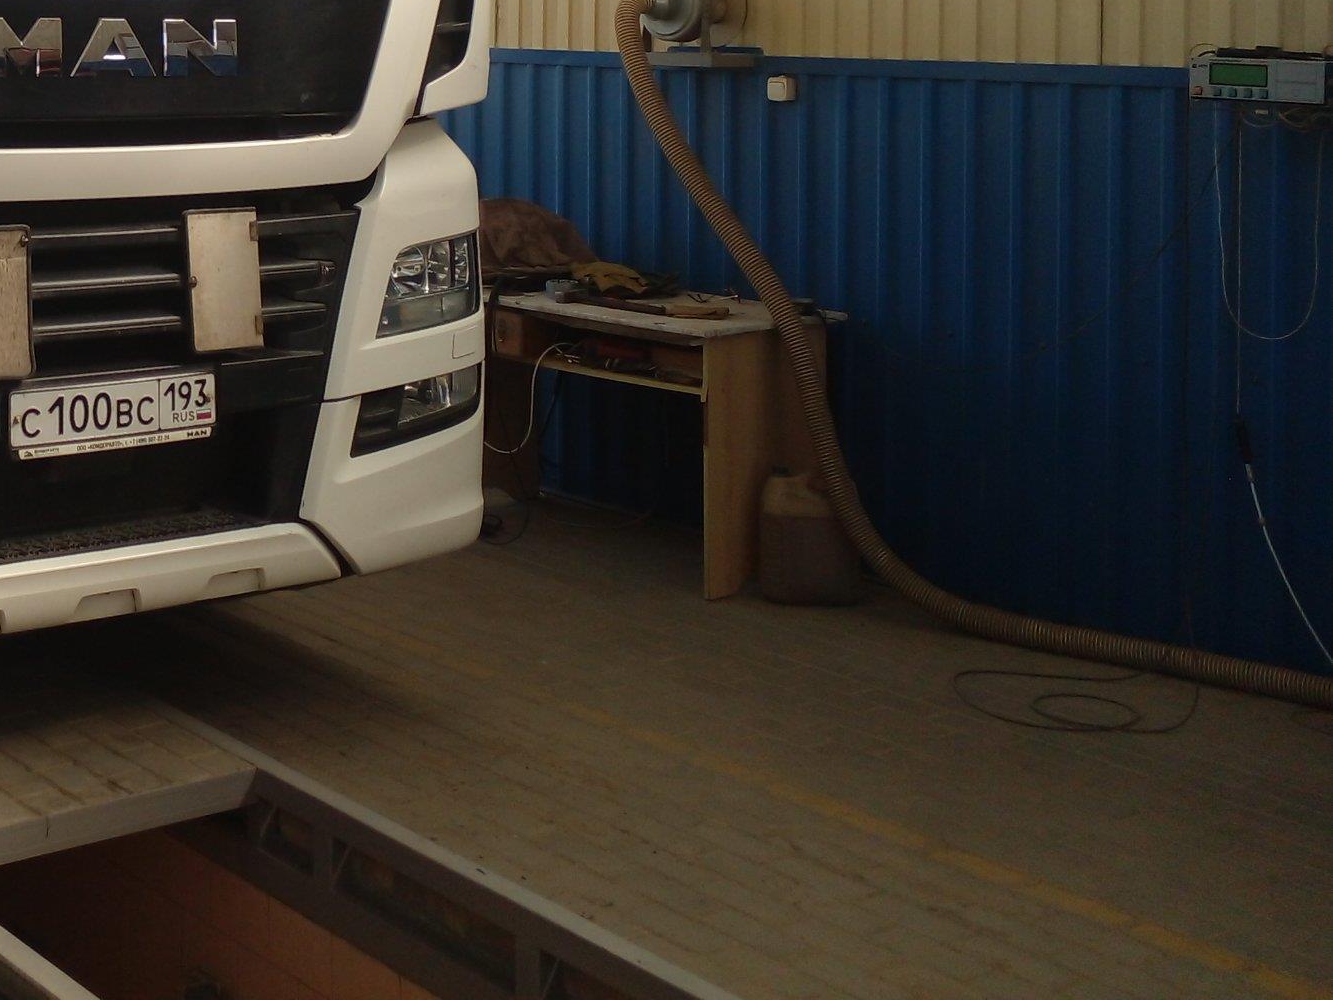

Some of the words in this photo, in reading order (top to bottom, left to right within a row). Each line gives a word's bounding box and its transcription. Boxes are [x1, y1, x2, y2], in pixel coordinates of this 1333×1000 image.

[164, 378, 208, 411] 193
[172, 411, 195, 423] RUS
[186, 428, 208, 438] MAN
